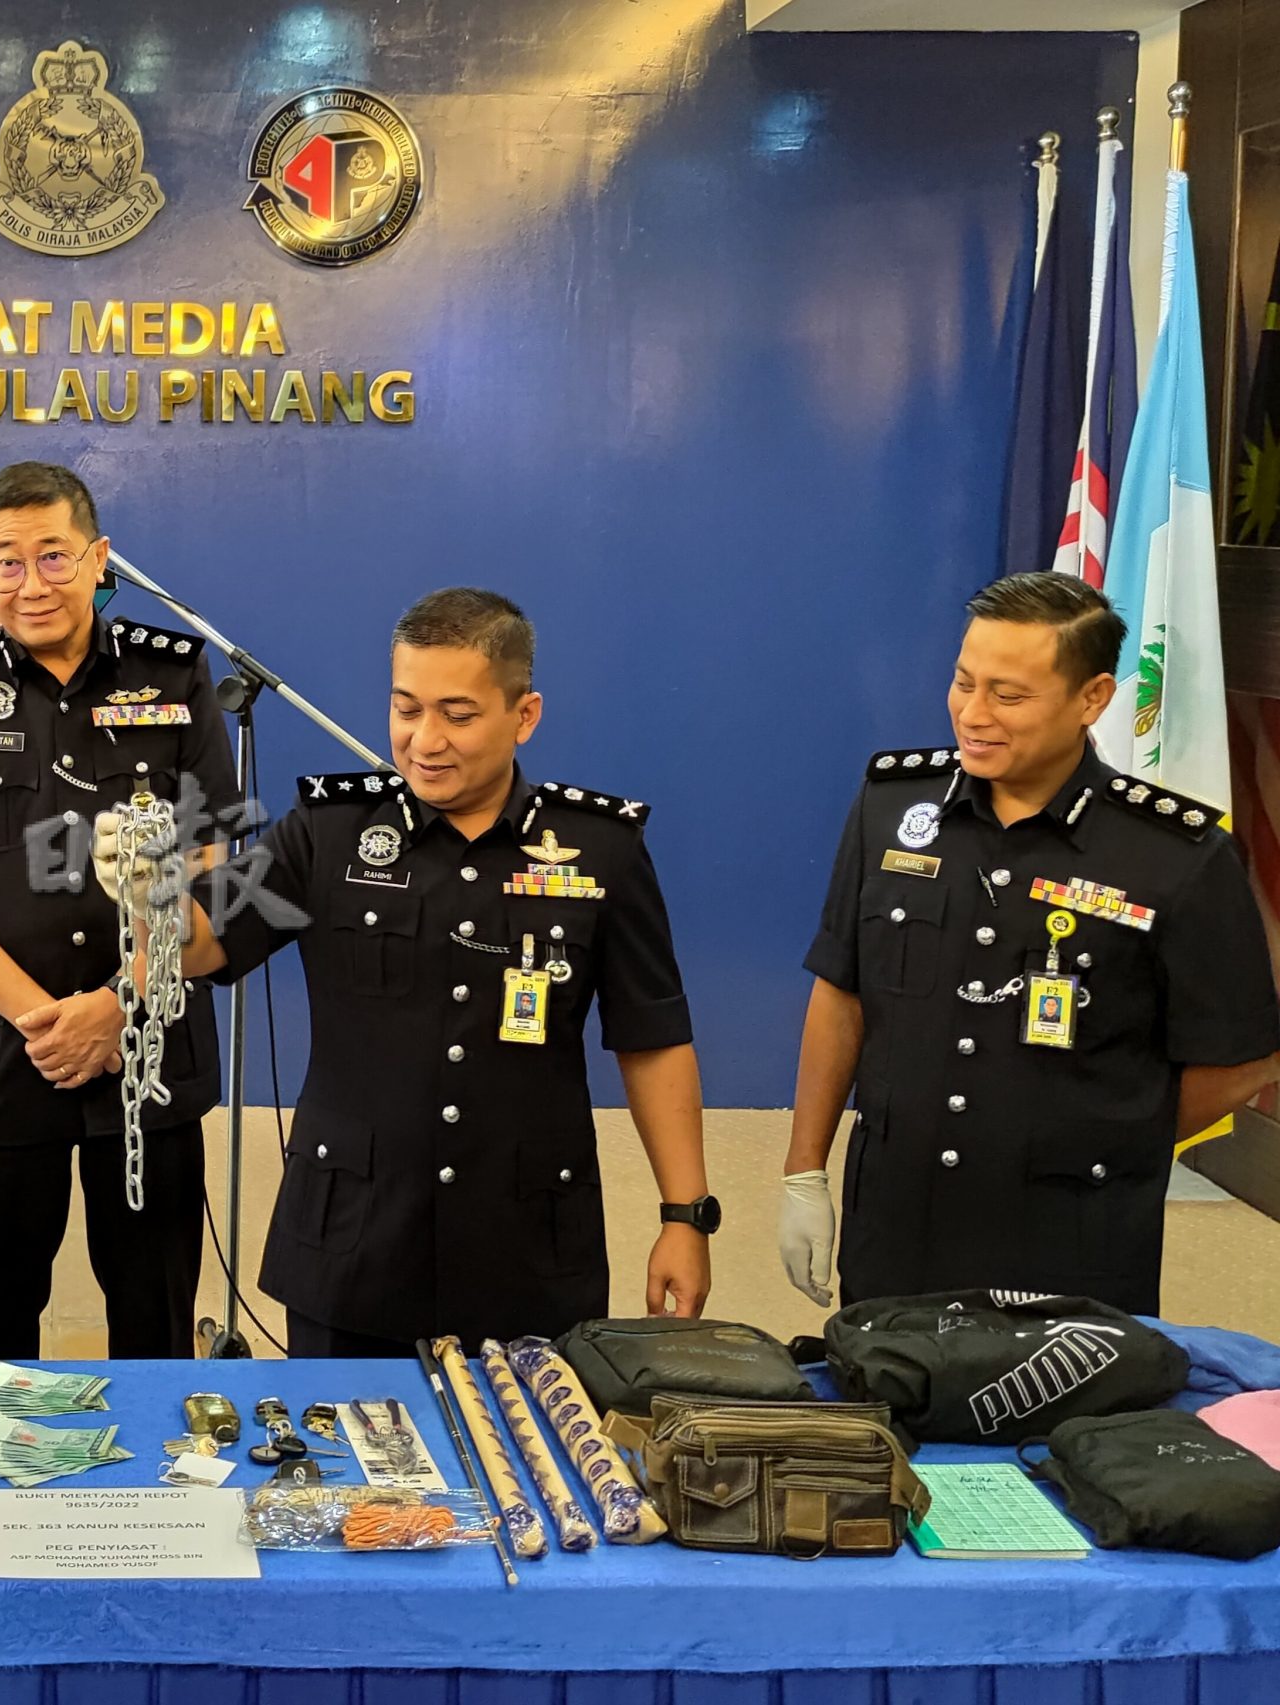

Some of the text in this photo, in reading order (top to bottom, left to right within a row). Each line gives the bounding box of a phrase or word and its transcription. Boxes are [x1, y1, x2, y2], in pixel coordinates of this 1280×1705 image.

[255, 93, 417, 177] PROTECTIVE PACTIVE PEOPLE ORIENTED
[283, 130, 386, 225] 4P
[0, 206, 144, 246] POLIS DIRAJA MALAYSIA
[259, 185, 416, 258] PERFORMANCE AND OUTCOME ORIENTED
[69, 300, 286, 355] MEDIA
[159, 368, 416, 424] PINANG
[0, 737, 14, 746] TAN
[363, 870, 393, 881] RAHIMI
[969, 1327, 1119, 1435] PUMA
[65, 1501, 140, 1509] 9635/2022
